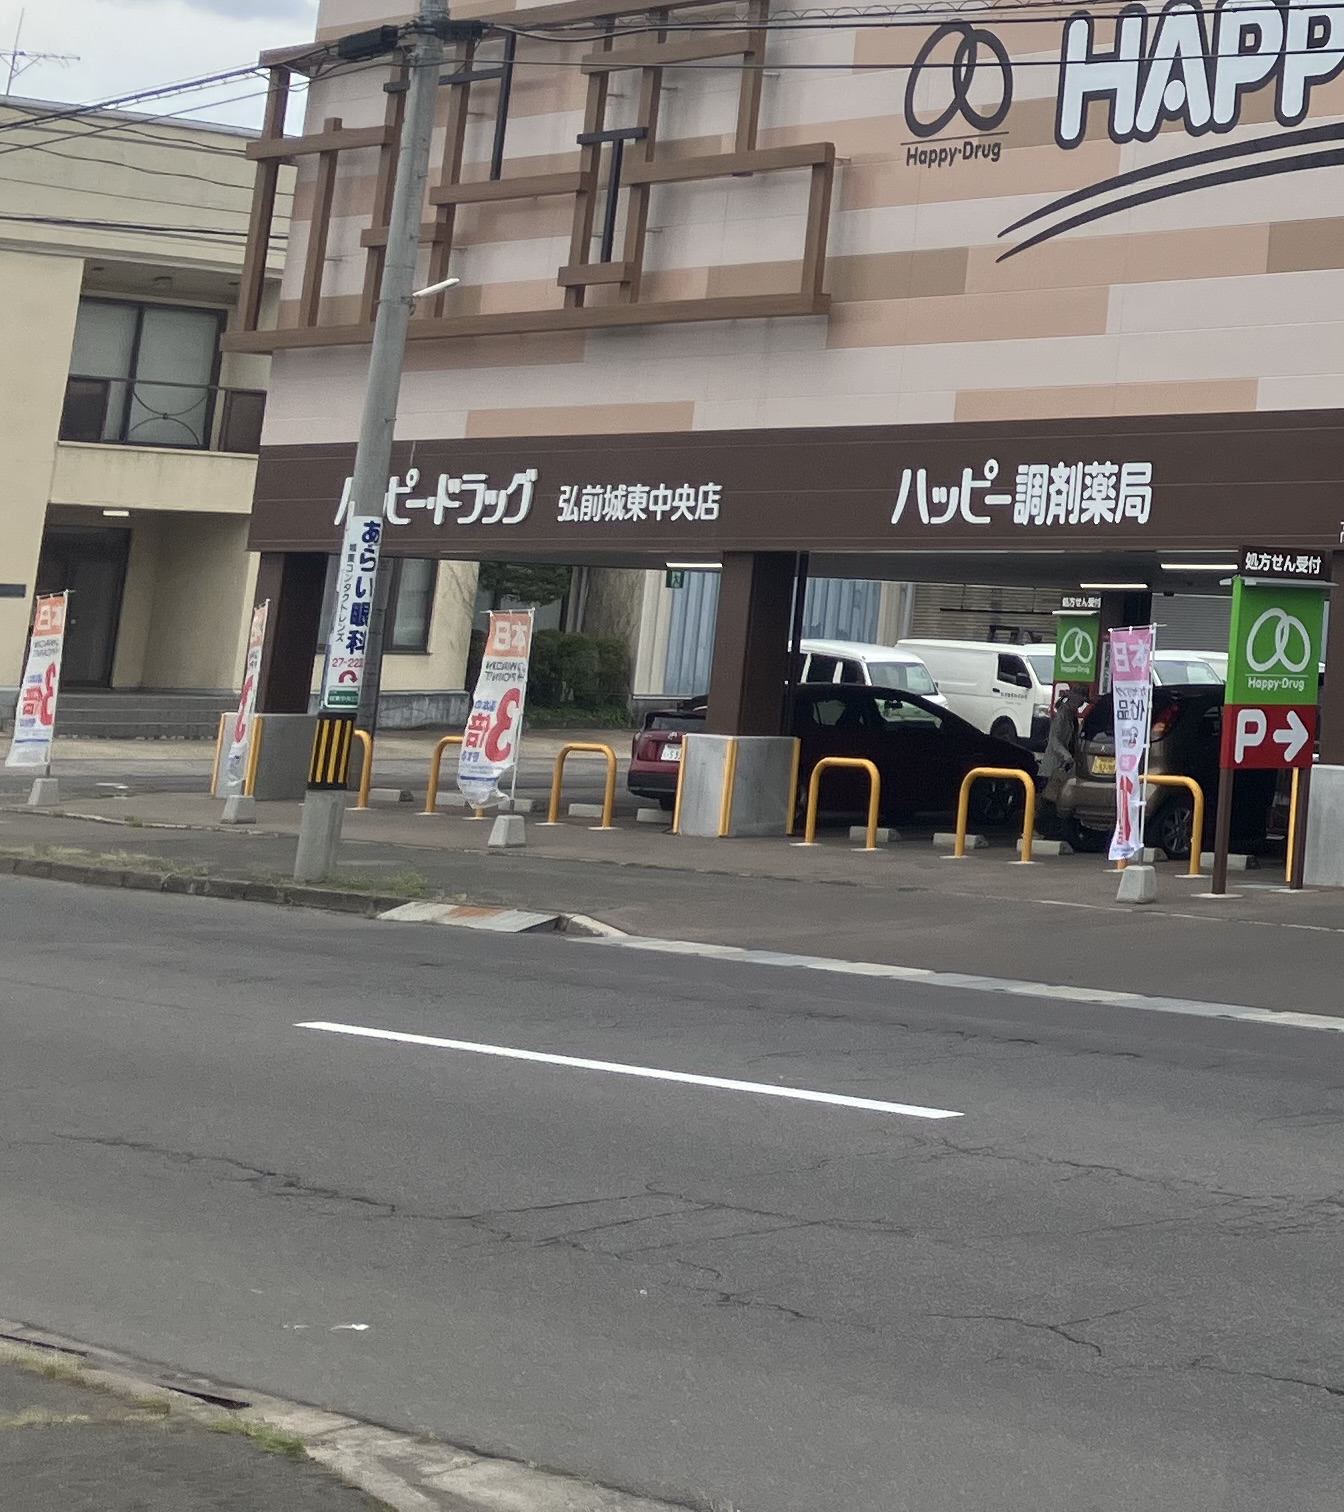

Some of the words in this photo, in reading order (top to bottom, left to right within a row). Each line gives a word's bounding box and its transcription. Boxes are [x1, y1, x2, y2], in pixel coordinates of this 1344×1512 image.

[556, 482, 723, 523] 弘前城東中央店
[891, 459, 1154, 526] ハッピー調剤薬局
[1245, 552, 1322, 574] 処方せん受付
[1233, 709, 1268, 765] P
